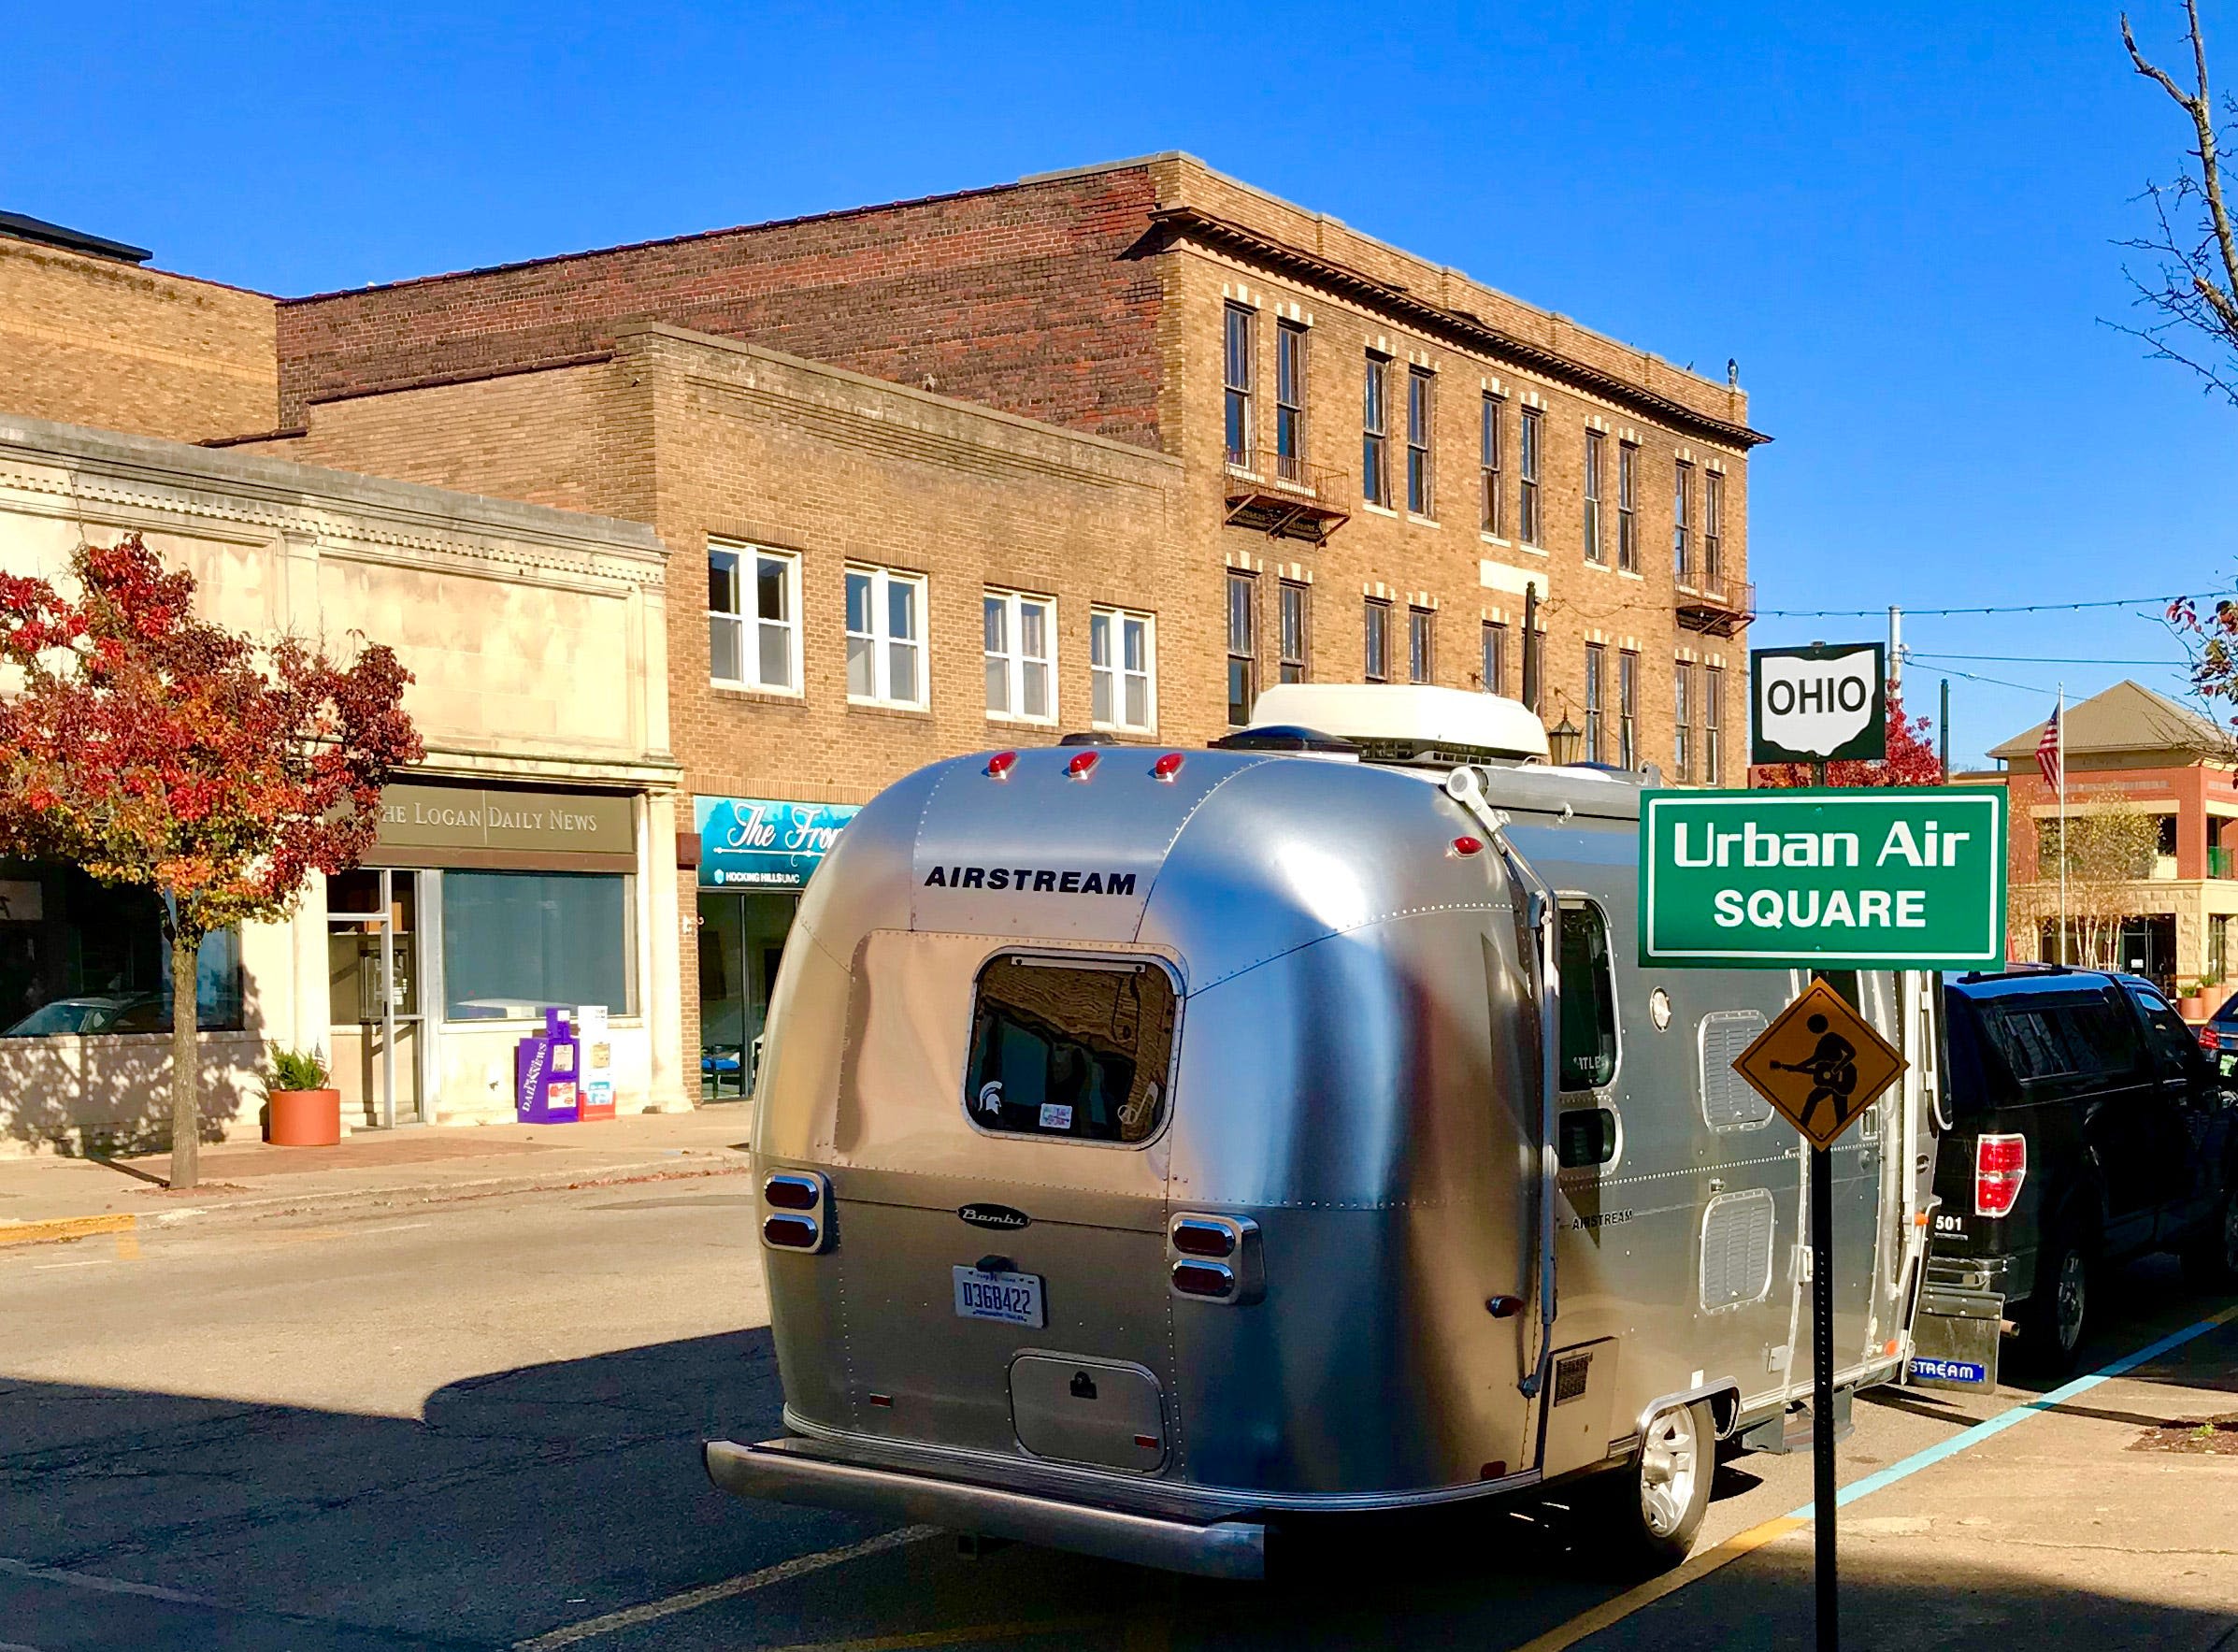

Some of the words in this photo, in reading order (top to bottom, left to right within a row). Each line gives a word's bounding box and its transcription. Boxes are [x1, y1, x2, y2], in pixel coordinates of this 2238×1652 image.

[1767, 675, 1867, 715] OHIO
[381, 805, 407, 824] HE
[414, 802, 481, 826] LOGAN
[488, 807, 543, 830] DAILY
[550, 810, 598, 832] NEWS
[726, 802, 777, 847] The
[785, 806, 849, 850] Fron
[1674, 822, 1858, 868] Urban
[1875, 820, 1970, 867] Air
[924, 866, 1137, 896] AIRSTREAM
[1714, 890, 1926, 929] SQUARE
[521, 1077, 538, 1112] DAILY
[962, 1208, 1025, 1226] Bambi
[1571, 1209, 1633, 1230] AIRSTREAM
[1935, 1215, 1963, 1231] 501
[1909, 1361, 1973, 1380] STREAM
